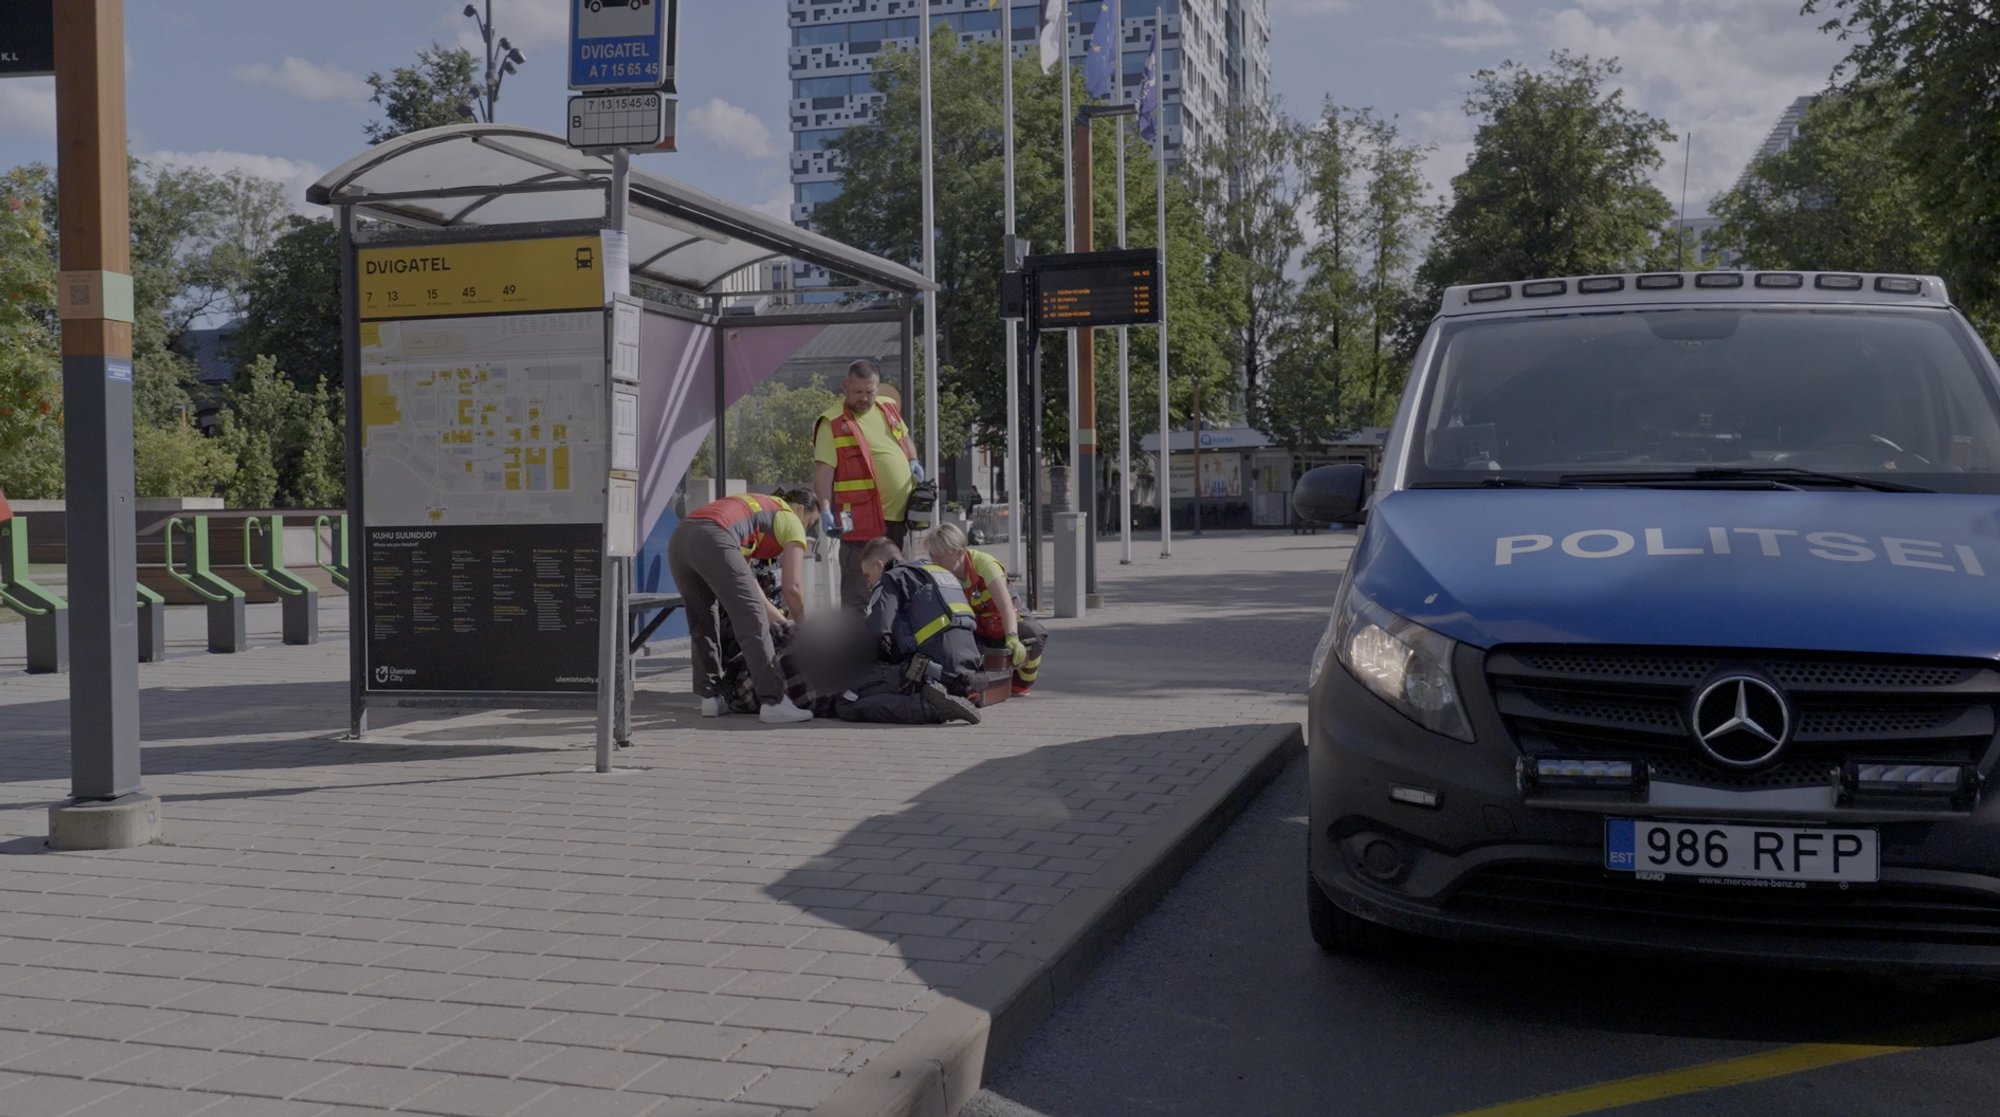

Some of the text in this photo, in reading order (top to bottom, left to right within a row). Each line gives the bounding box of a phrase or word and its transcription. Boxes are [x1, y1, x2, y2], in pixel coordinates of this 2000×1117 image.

[12, 52, 19, 61] L
[581, 42, 650, 60] DVIGATEL
[589, 62, 659, 78] A 7 15 65 45
[588, 97, 657, 110] 7 13 15 45 49
[572, 116, 582, 128] B
[366, 257, 451, 275] DVIGATEL
[366, 284, 516, 302] 7 13 15 45 49
[372, 531, 437, 540] KUHU SUUNDUD?
[1494, 526, 1987, 578] POLITSEI
[1610, 827, 1863, 873] EST 986 RFP
[1698, 876, 1807, 889] www.mercedes-benz.ee
